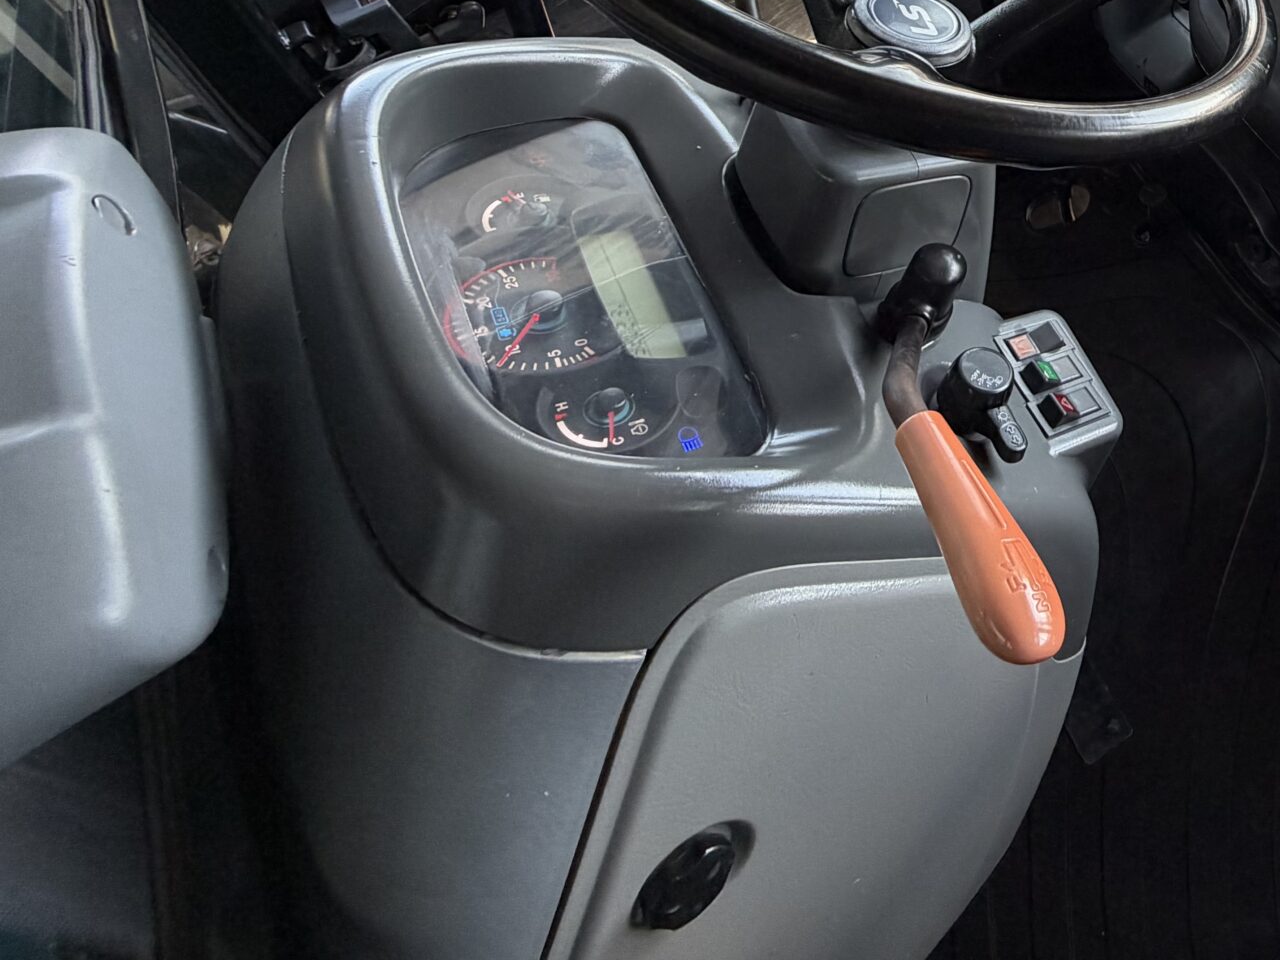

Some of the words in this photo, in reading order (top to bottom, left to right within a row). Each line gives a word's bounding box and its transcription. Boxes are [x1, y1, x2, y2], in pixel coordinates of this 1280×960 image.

[502, 275, 519, 290] 25
[476, 296, 492, 308] 20
[575, 338, 588, 347] 0
[548, 349, 561, 358] 5
[555, 401, 569, 412] H
[612, 436, 625, 446] C
